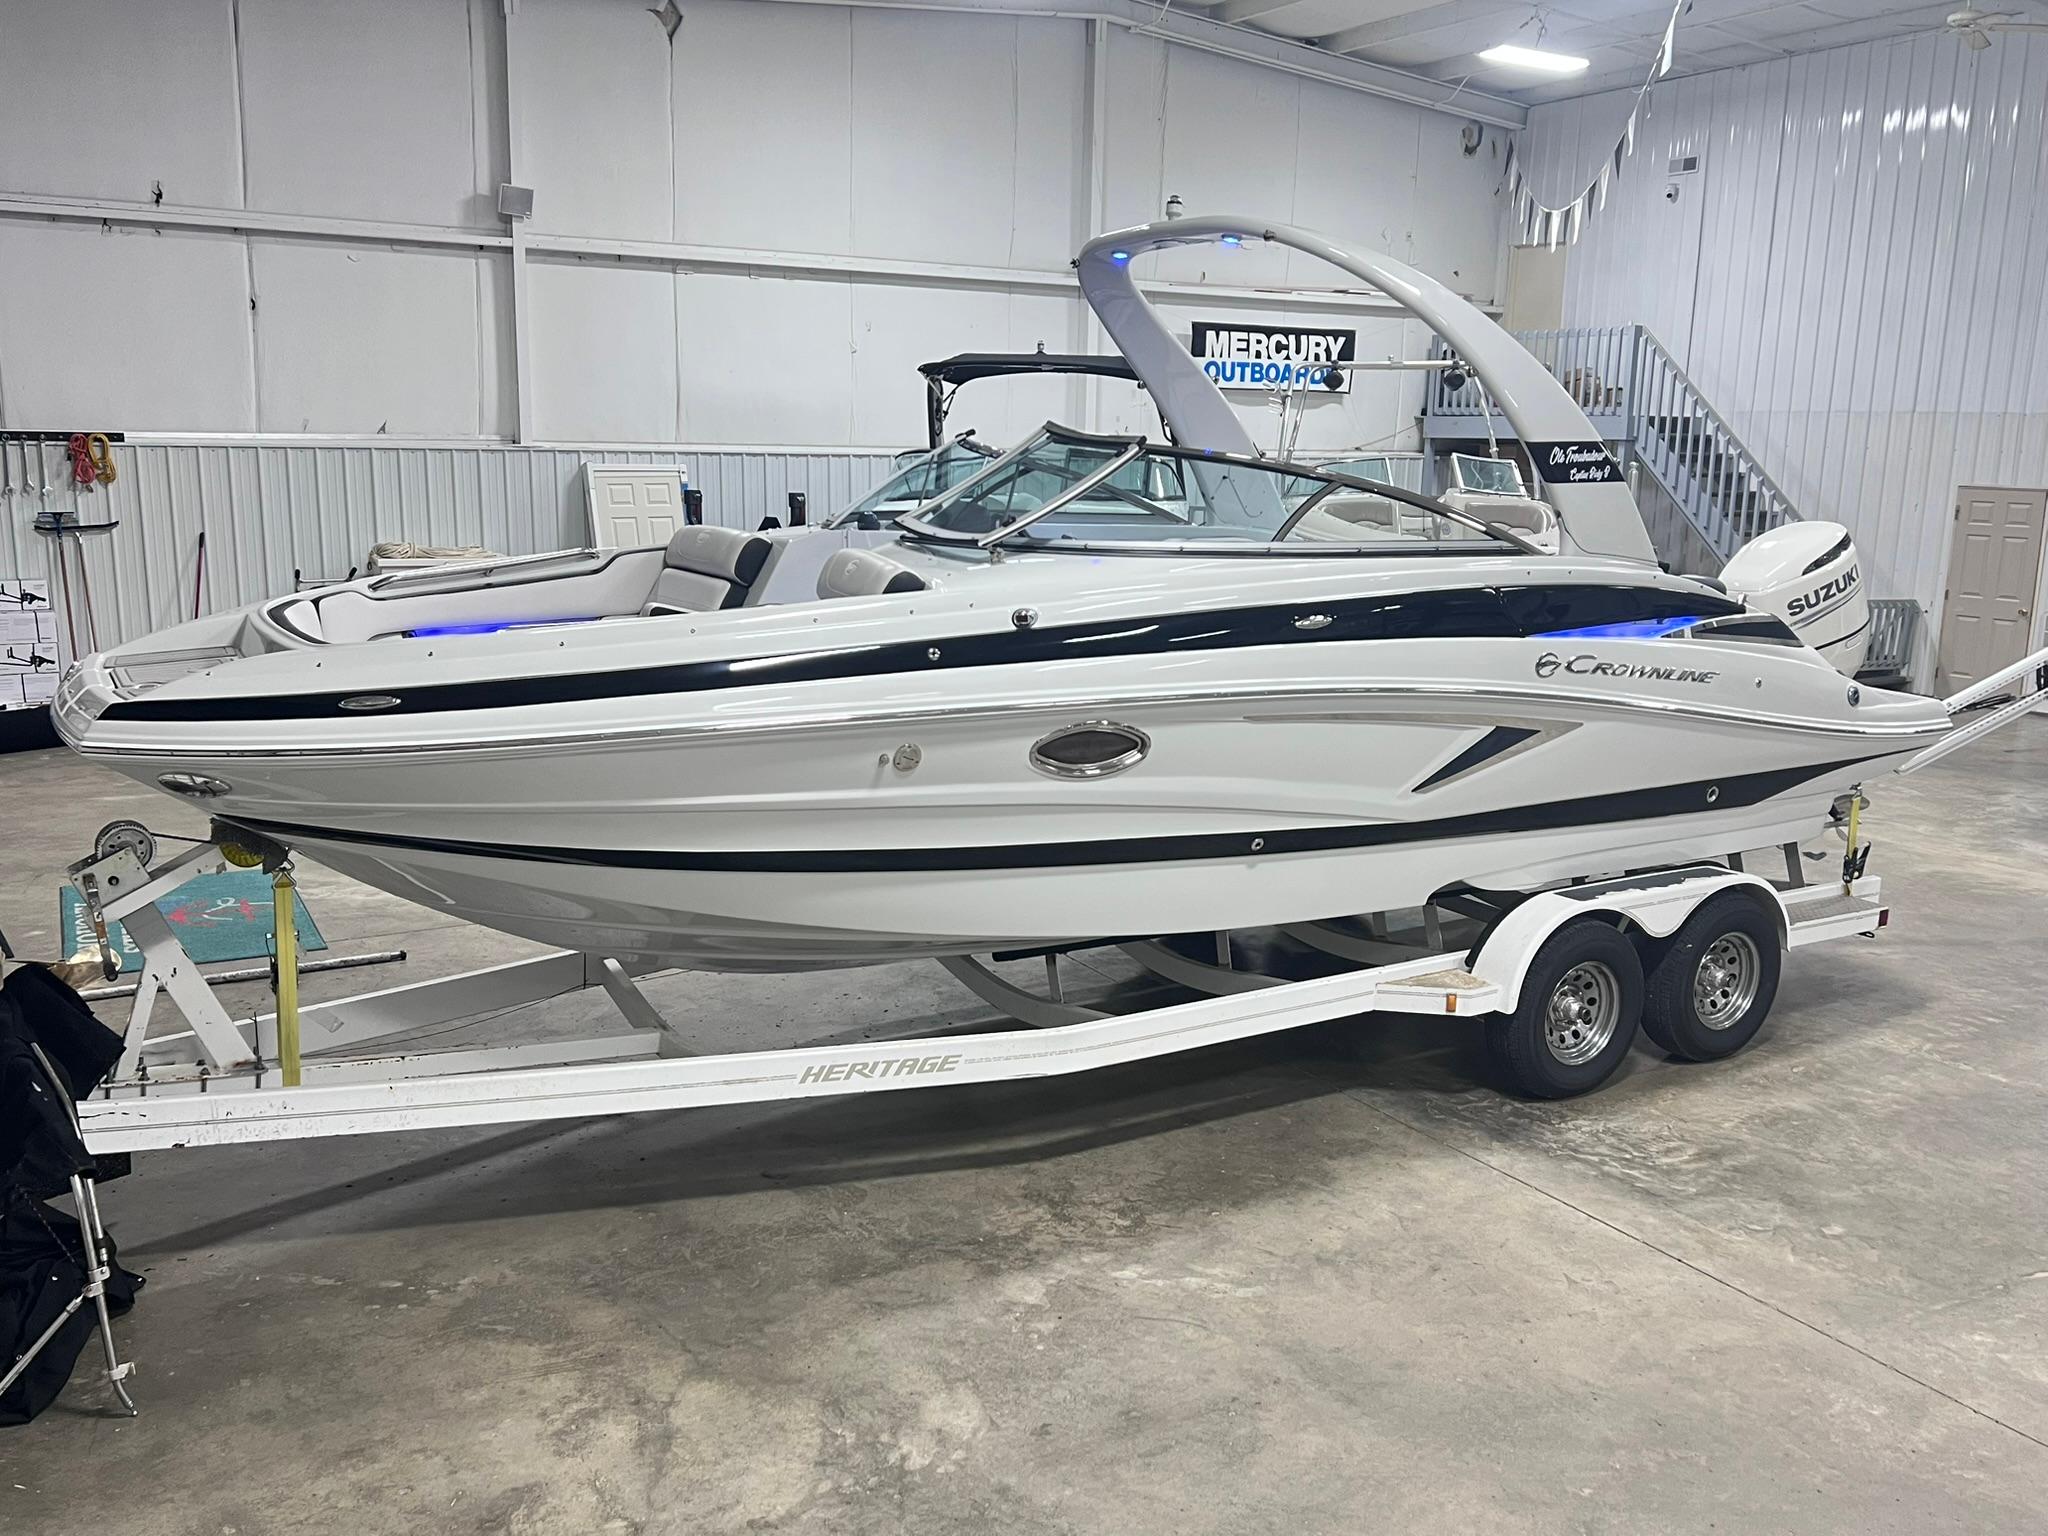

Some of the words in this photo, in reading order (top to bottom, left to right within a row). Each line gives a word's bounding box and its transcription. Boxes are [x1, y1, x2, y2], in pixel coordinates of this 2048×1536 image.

[1205, 330, 1347, 362] MERCURY
[1204, 360, 1331, 384] OUTBOARD
[1787, 564, 1860, 617] SUZUKI
[798, 1054, 963, 1085] HERITAGE
